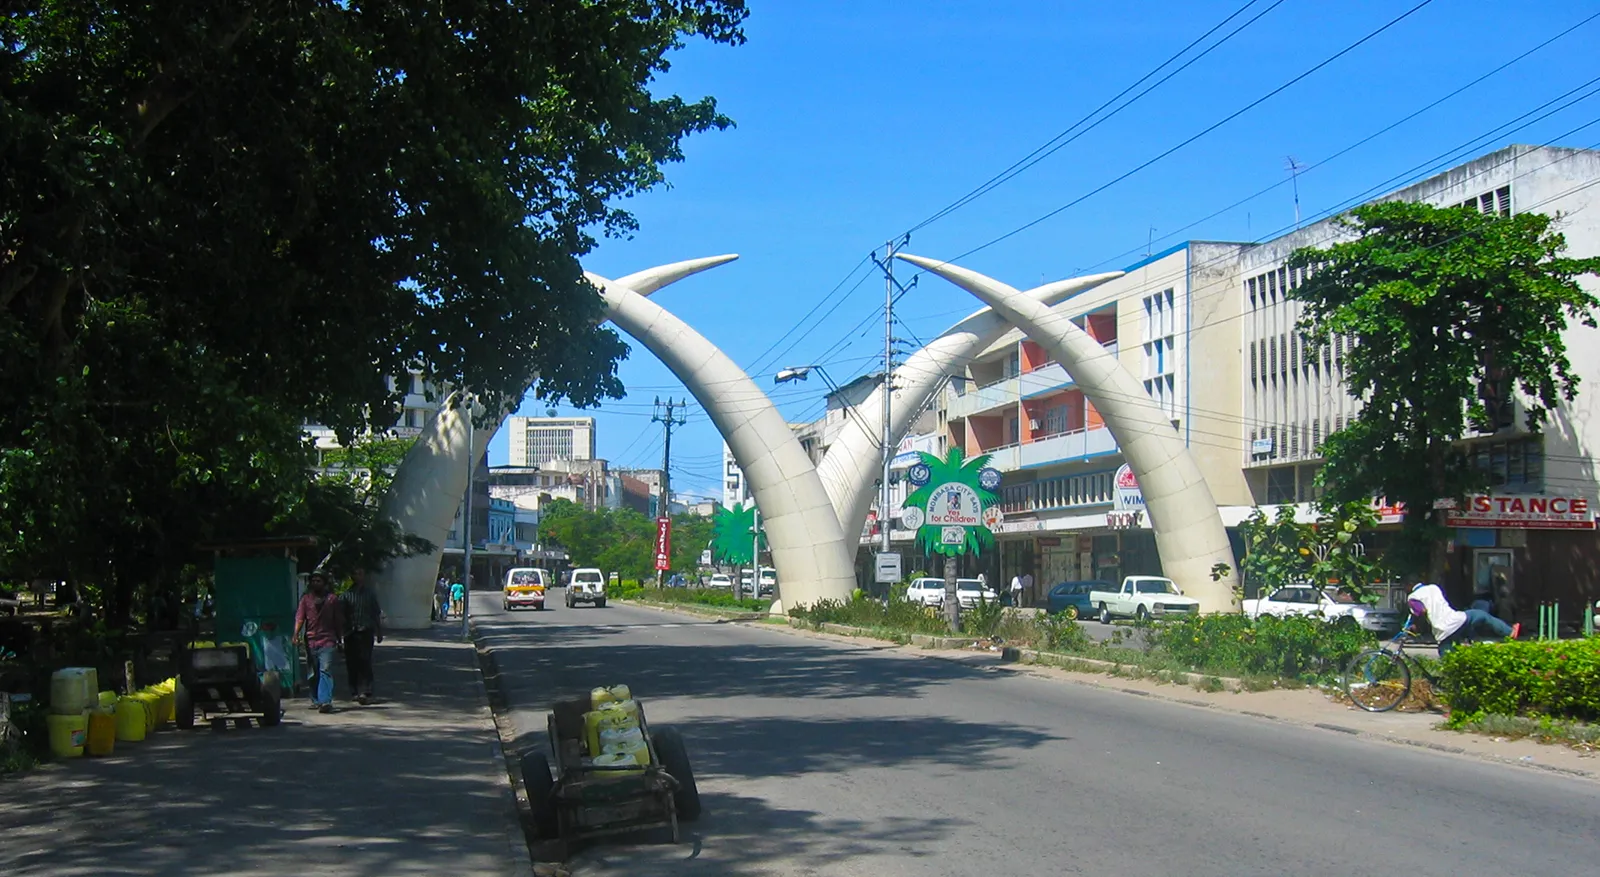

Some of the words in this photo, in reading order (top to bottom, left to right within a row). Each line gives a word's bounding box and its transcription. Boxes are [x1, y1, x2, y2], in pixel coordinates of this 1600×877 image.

[929, 485, 954, 512] MOMBASA
[956, 485, 972, 495] CITY
[969, 496, 979, 514] SAYS
[1449, 497, 1588, 514] ISTANCE
[931, 515, 942, 523] for
[943, 515, 977, 523] Children
